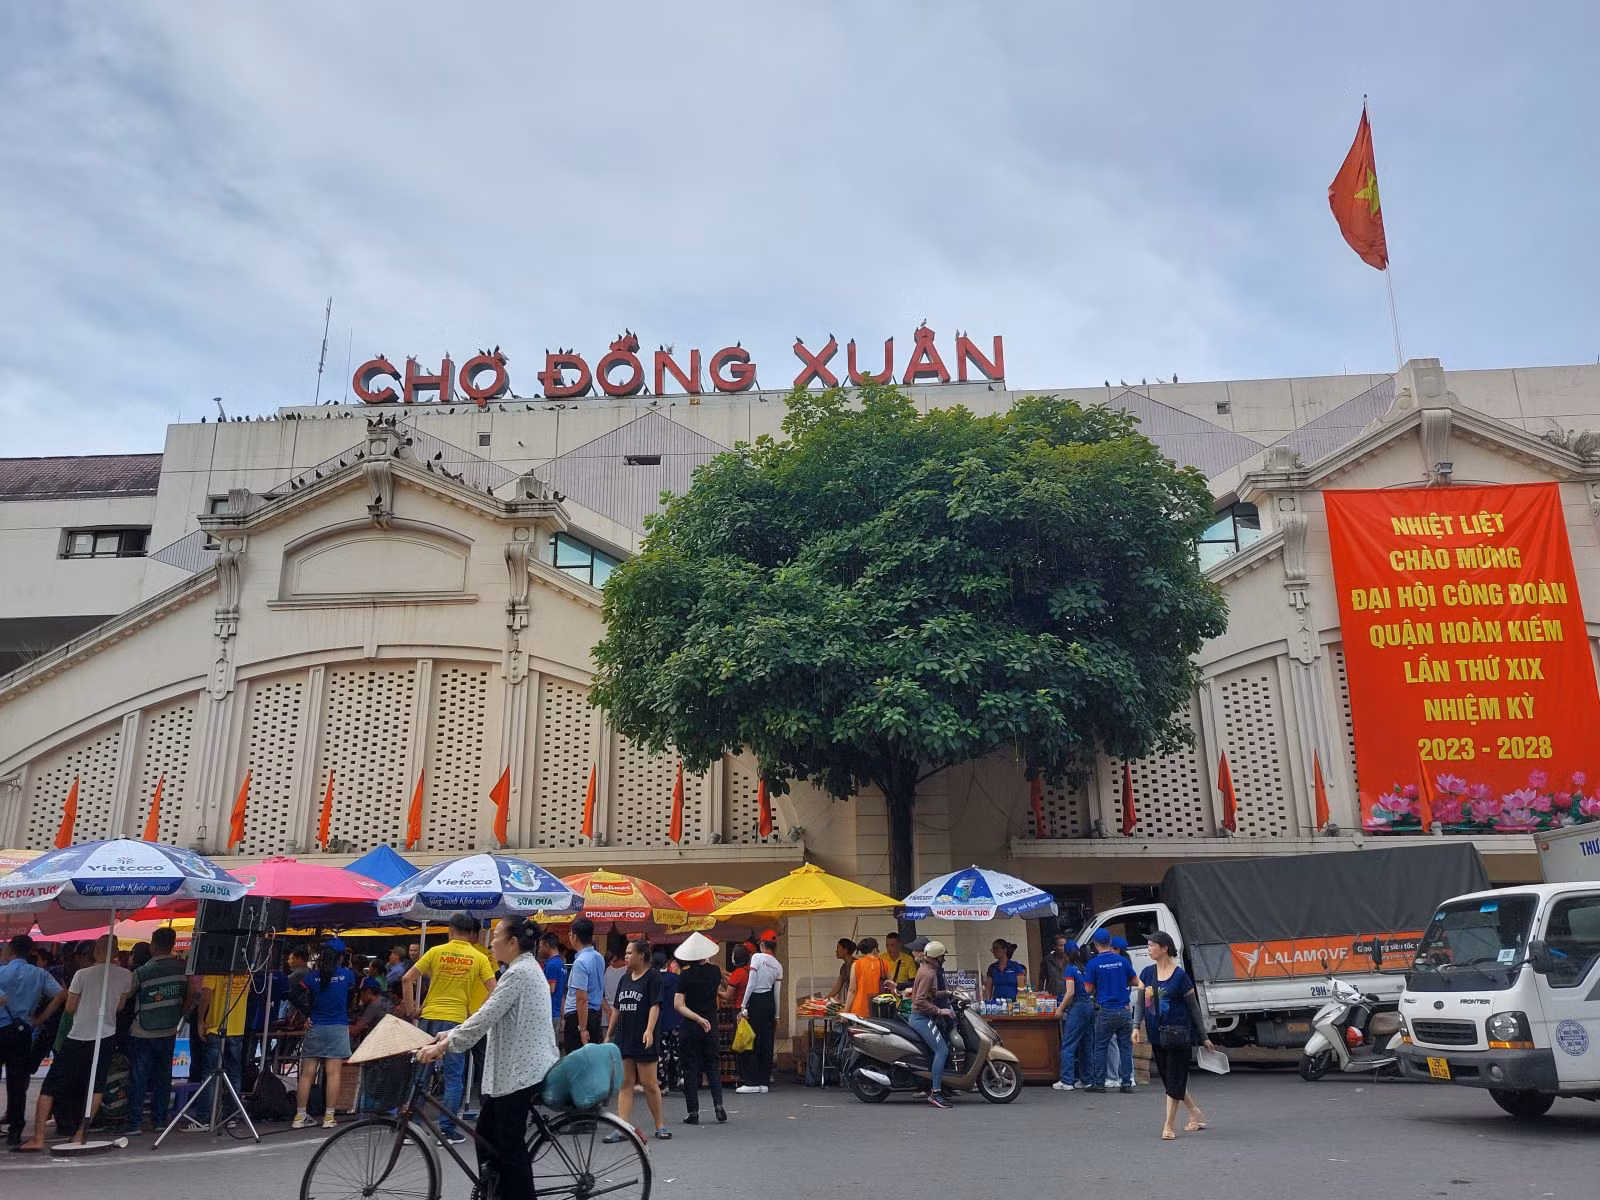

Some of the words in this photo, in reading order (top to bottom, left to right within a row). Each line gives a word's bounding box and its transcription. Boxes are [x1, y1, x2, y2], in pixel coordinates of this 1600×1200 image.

[353, 349, 510, 408] CHỢ
[793, 326, 1005, 388] XUÂN
[1391, 512, 1454, 540] NHIỆT
[1459, 510, 1505, 537] LIỆT
[1389, 545, 1451, 572] CHÀO
[1456, 543, 1522, 569] MỪNG
[1352, 587, 1391, 614] ĐẠI
[1397, 581, 1437, 612] HỘI
[1442, 579, 1504, 606] CÔNG
[1508, 578, 1568, 605] ĐOÀN
[1370, 618, 1434, 650] QUẬN
[1440, 616, 1503, 644] HOÀN
[1507, 613, 1564, 642] KIẾM
[1403, 653, 1450, 683] LẦN
[1455, 654, 1500, 682] THỨ
[1505, 657, 1545, 681] XIX
[1423, 692, 1501, 726] NHIỆM
[1506, 691, 1535, 719] KỲ
[1417, 738, 1475, 761] 2023
[1497, 736, 1553, 760] 2028
[87, 863, 165, 872] Vietcoco
[437, 878, 493, 886] Vietcoco
[517, 896, 533, 906] SỮA
[936, 908, 956, 916] NƯỚC
[957, 908, 972, 916] DỪA
[973, 908, 990, 916] TƯƠI
[1264, 947, 1349, 965] LALAMOVE
